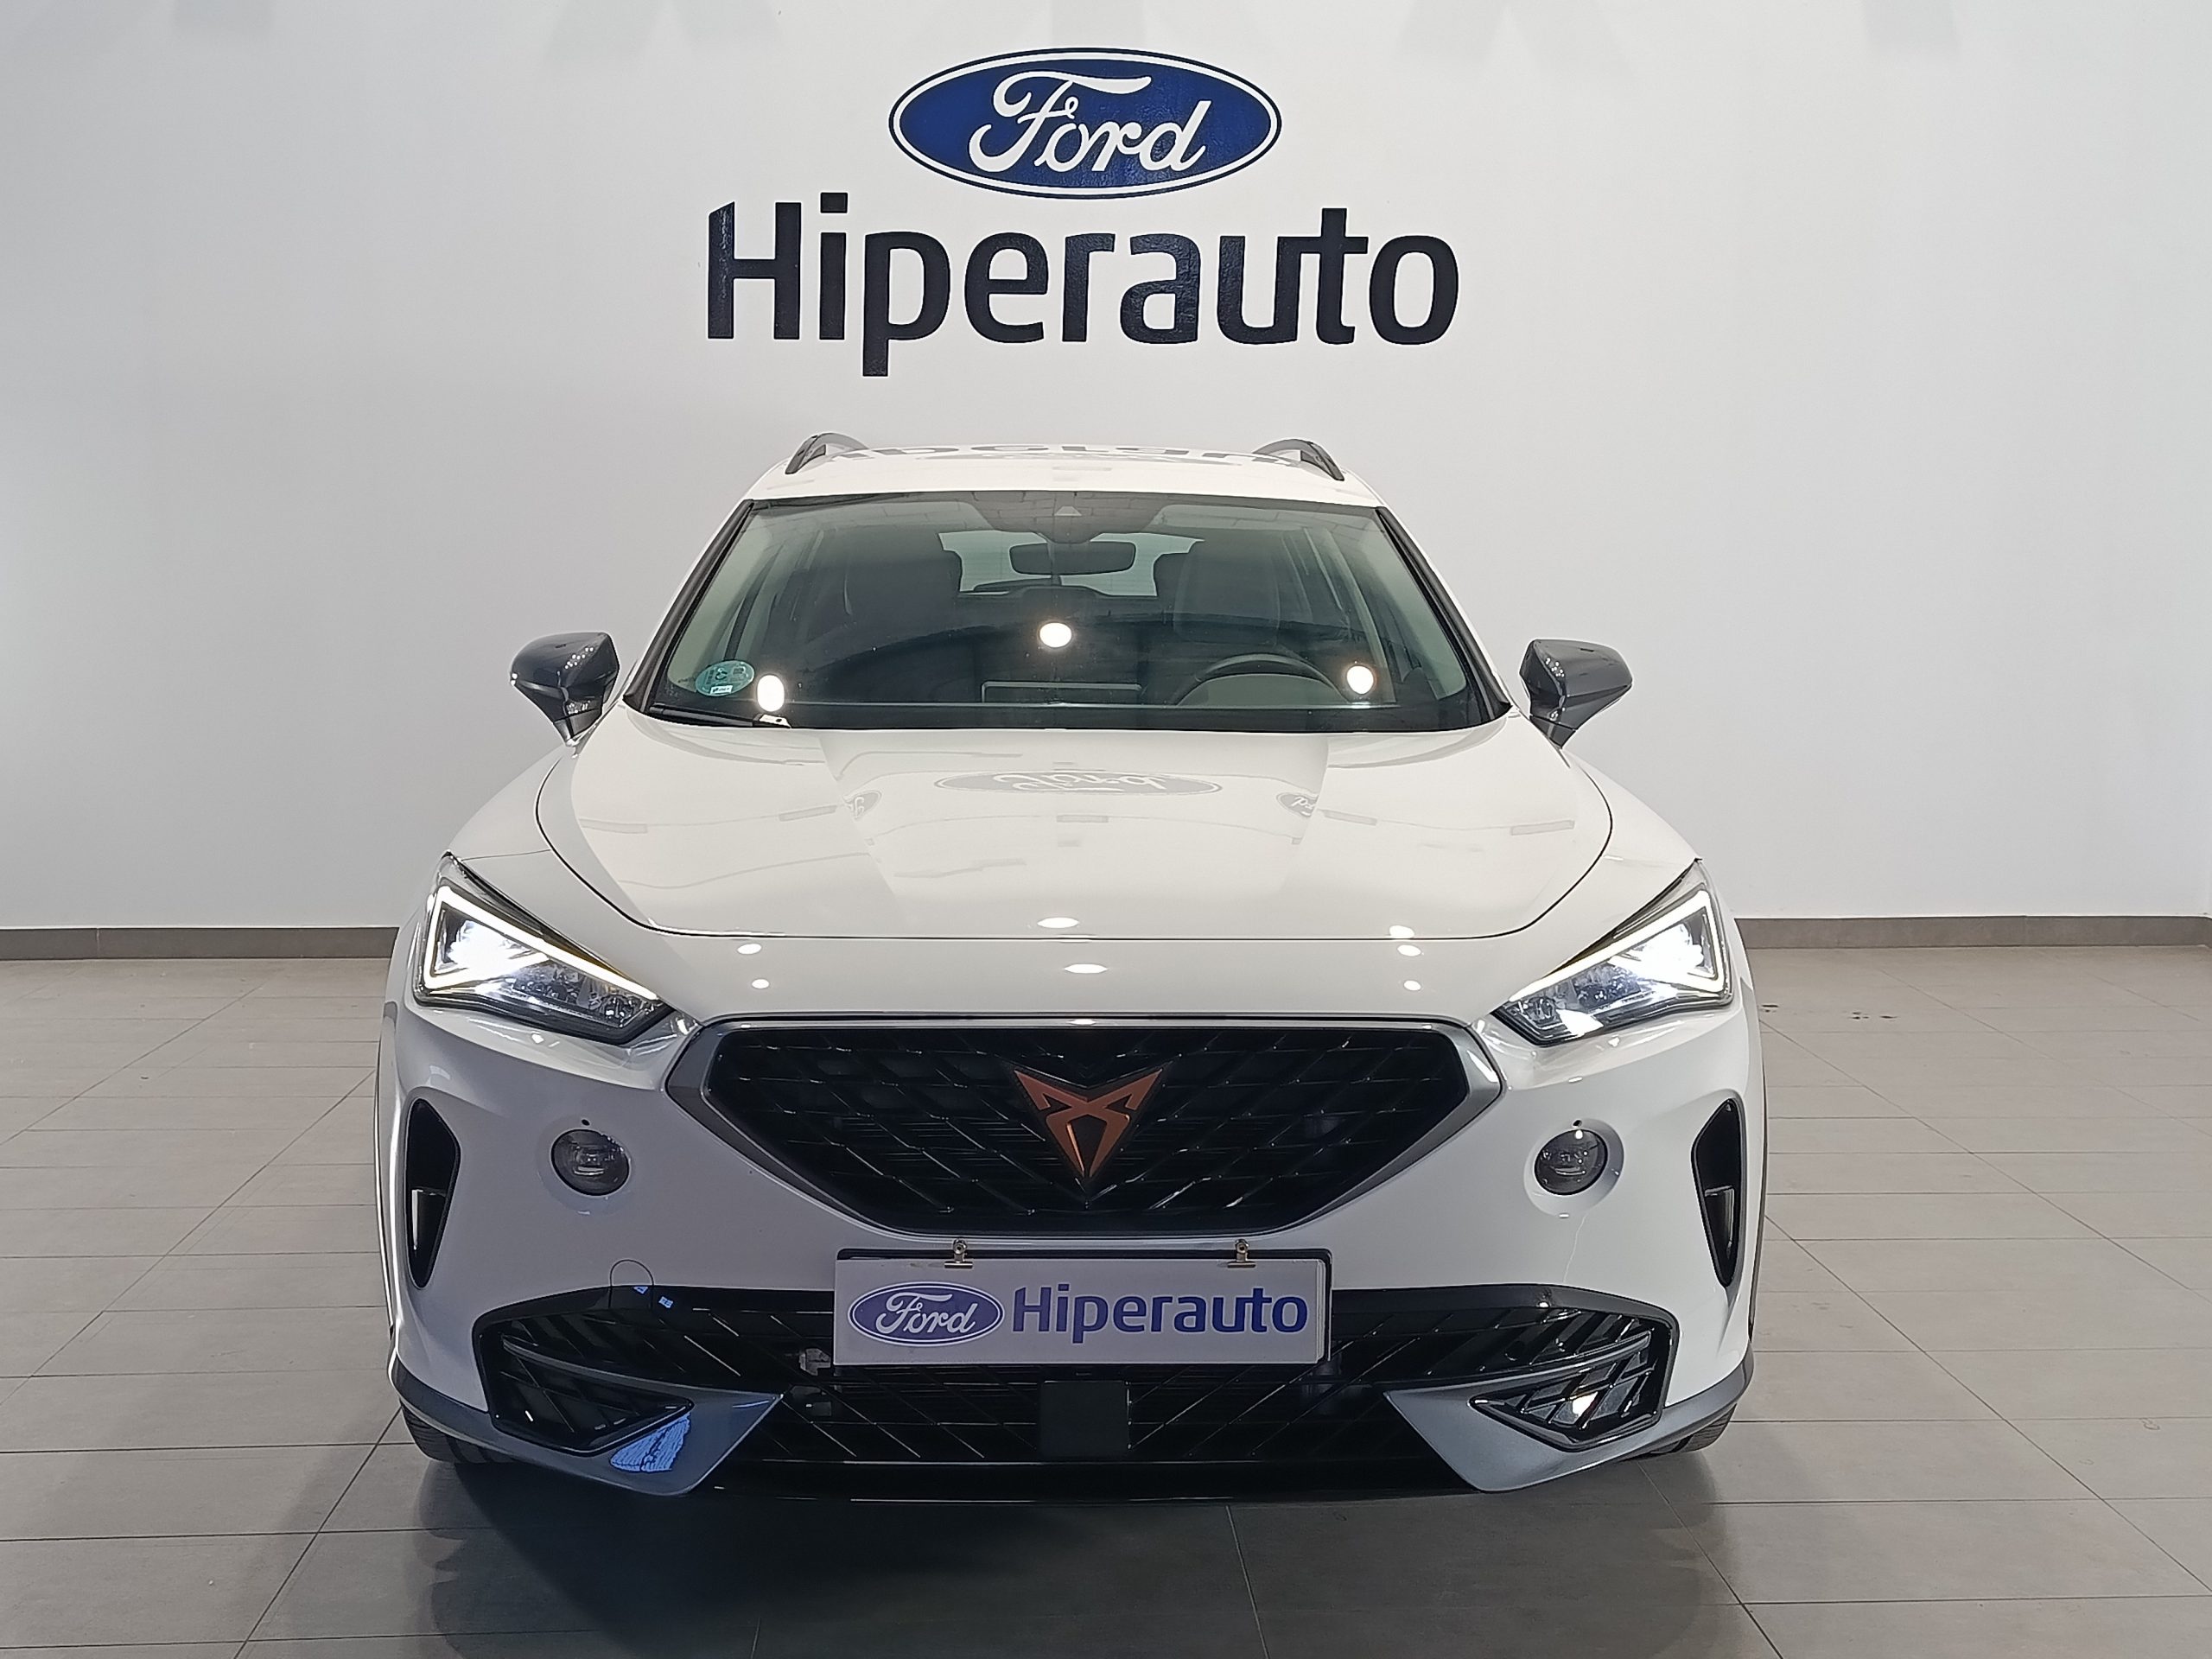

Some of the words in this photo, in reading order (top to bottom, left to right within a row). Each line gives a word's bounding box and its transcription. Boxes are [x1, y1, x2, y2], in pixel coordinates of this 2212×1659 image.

[969, 71, 1211, 174] Ford
[707, 191, 1460, 378] Hiperauto
[875, 1291, 978, 1334] Ford
[1012, 1282, 1308, 1344] Hiperauto
